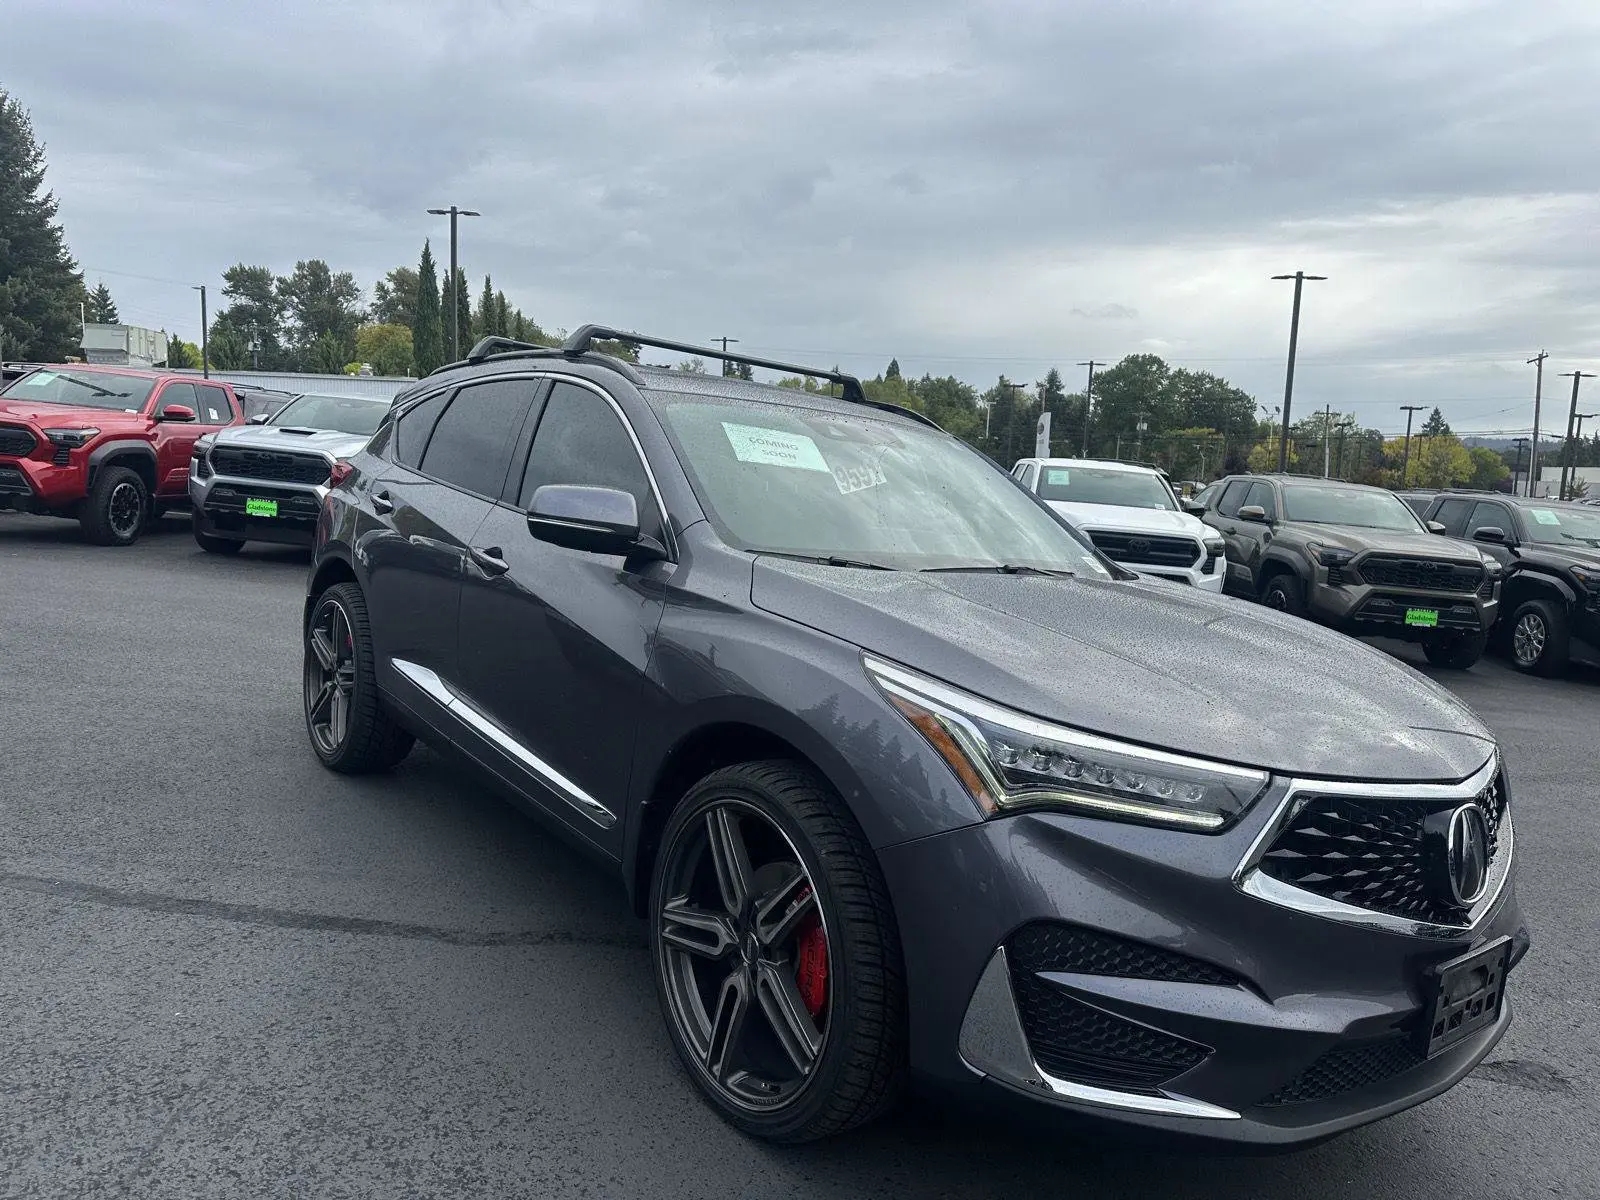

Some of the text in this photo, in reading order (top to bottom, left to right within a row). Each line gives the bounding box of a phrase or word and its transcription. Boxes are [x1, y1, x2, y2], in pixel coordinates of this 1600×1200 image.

[749, 437, 799, 450] COMING
[762, 449, 797, 460] SOON
[247, 503, 276, 513] Gladstone
[1406, 613, 1437, 623] Gladstone
